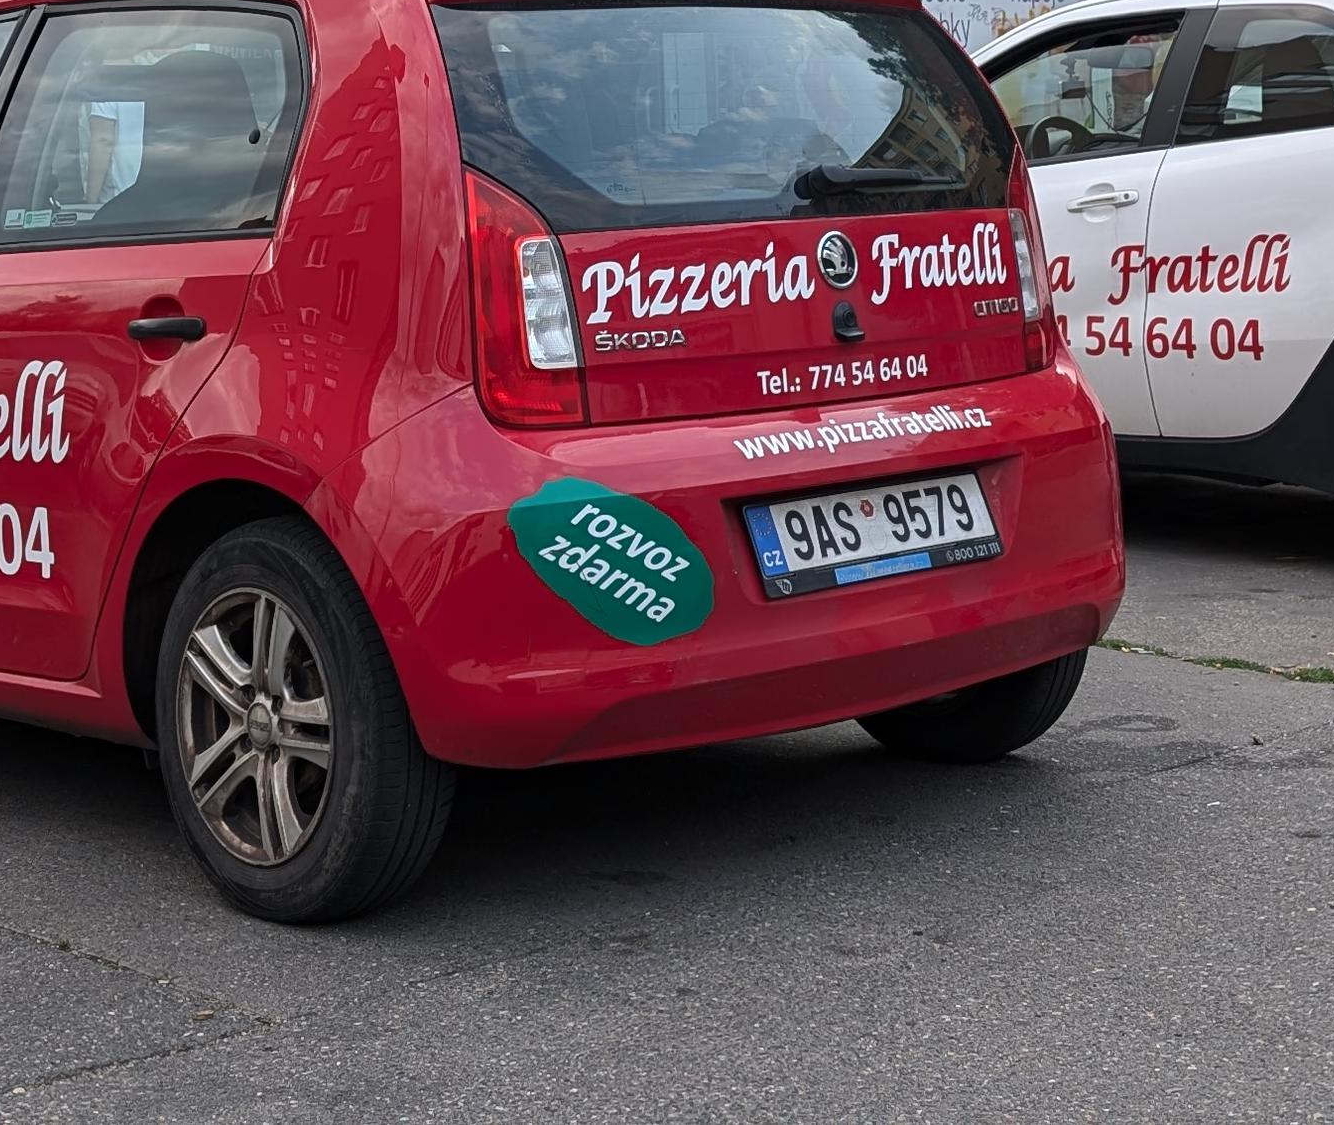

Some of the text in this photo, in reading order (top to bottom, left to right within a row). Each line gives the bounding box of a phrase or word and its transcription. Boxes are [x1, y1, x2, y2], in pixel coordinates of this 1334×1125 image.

[583, 241, 815, 324] Pizzeria
[872, 222, 1007, 305] Fratelli
[1107, 234, 1291, 305] Fratelli
[594, 327, 688, 353] ŠKODA
[1085, 315, 1132, 357] 54
[1146, 317, 1196, 360] 64
[1210, 318, 1264, 362] 04
[757, 354, 929, 395] Tel.: 774 54 64 04
[733, 406, 992, 461] www.pizzafratelli.cz
[570, 501, 690, 583] rozvoz
[785, 483, 975, 561] 9AS 9579
[538, 531, 675, 624] zdarma
[763, 550, 784, 568] CZ
[954, 545, 974, 561] 800
[975, 544, 988, 557] 121
